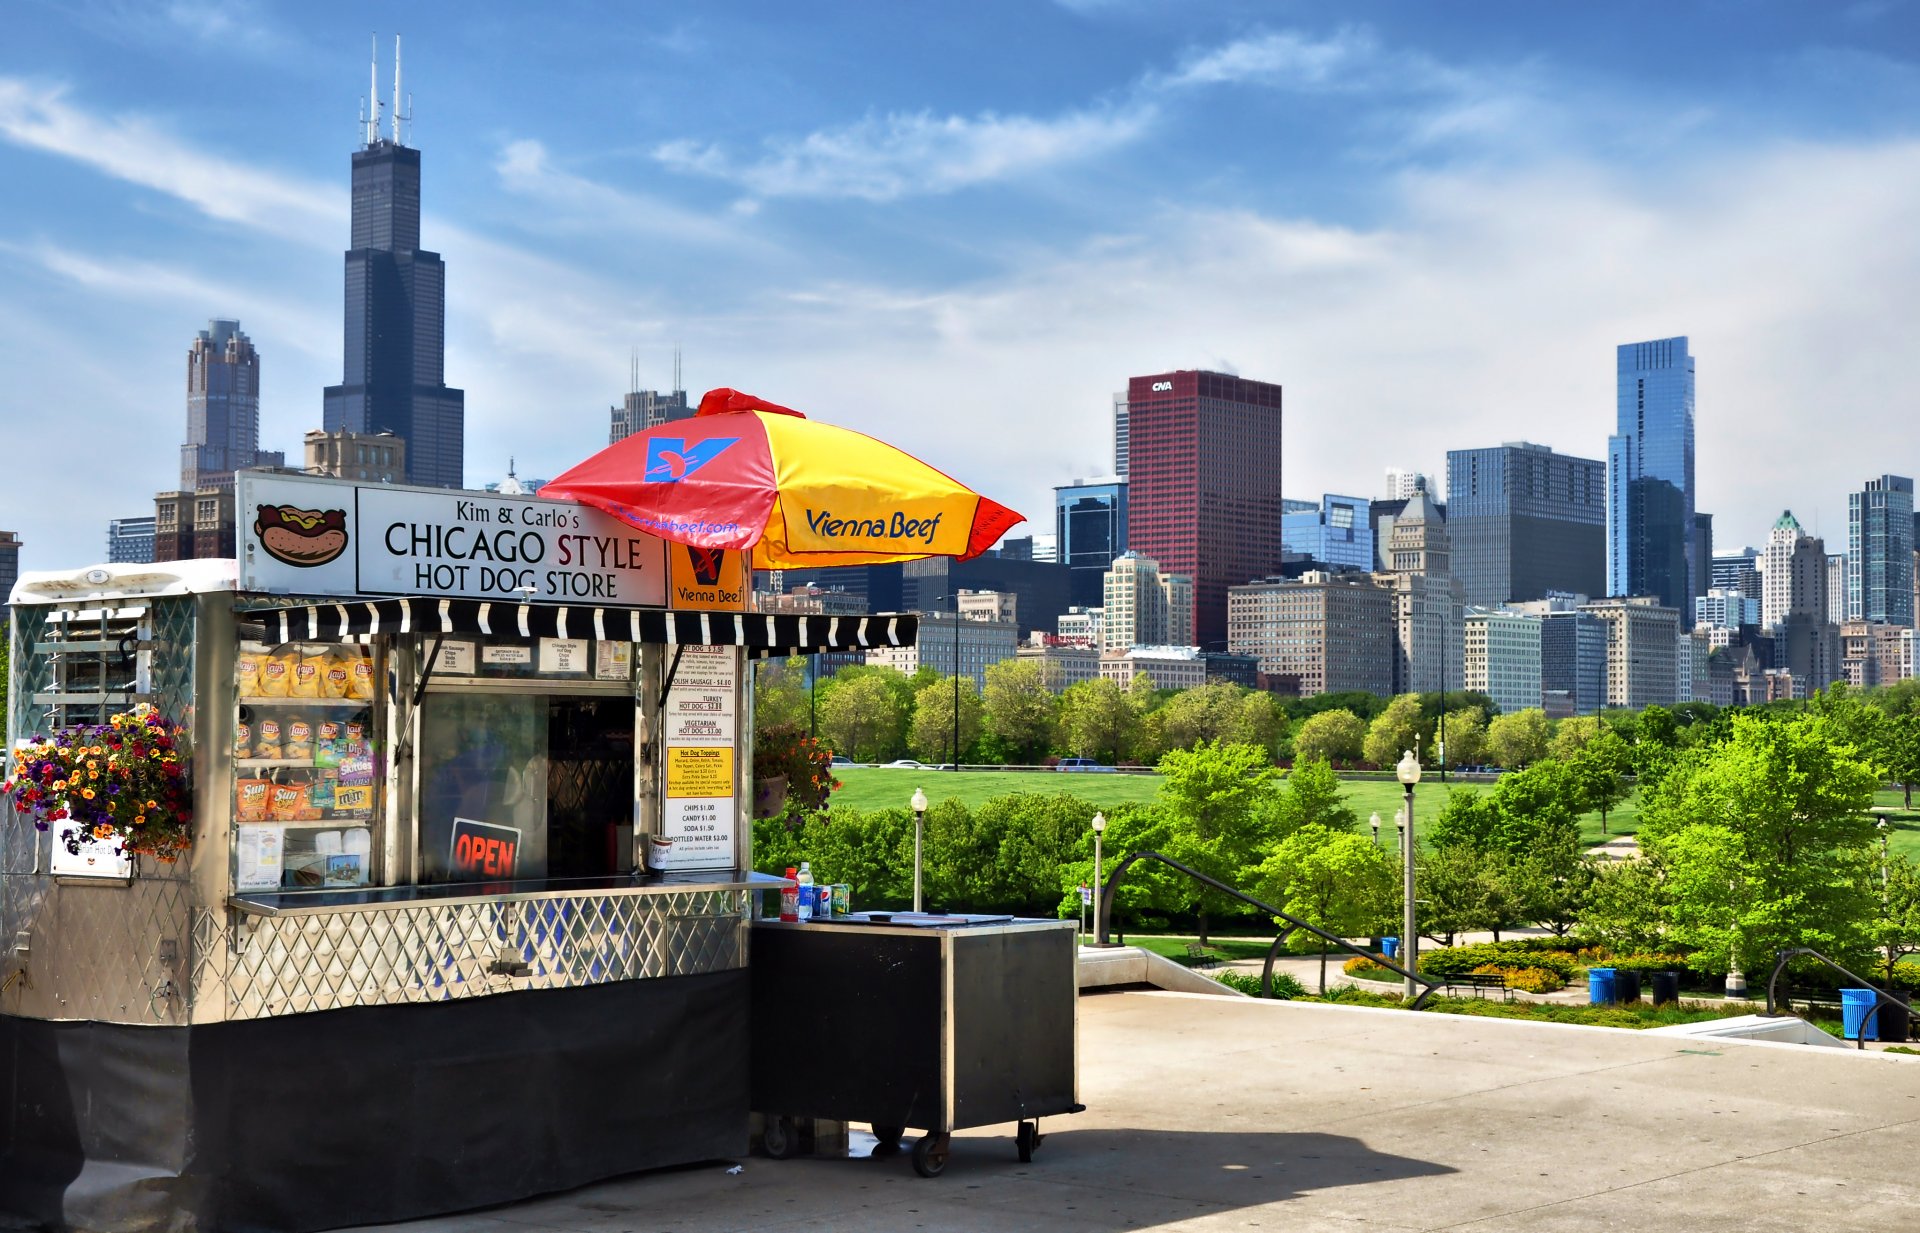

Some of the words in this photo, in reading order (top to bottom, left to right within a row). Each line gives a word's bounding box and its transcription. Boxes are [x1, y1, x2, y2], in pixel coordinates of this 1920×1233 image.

[1152, 382, 1172, 392] CNA
[457, 500, 490, 522] Kim
[498, 507, 514, 524] &
[521, 506, 579, 529] Carlo's
[806, 509, 885, 537] Vienna
[889, 511, 943, 544] Beef
[384, 522, 545, 564] CHICAGO
[558, 534, 643, 570] STYLE
[415, 563, 470, 590] HOT
[481, 567, 536, 594] DOG
[546, 571, 618, 598] STORE
[678, 587, 715, 602] Vienna
[718, 586, 743, 602] Beef
[690, 678, 712, 686] SAUSAGE
[348, 743, 363, 756] Dip
[689, 749, 700, 757] Dog
[700, 749, 720, 757] Toppings
[341, 760, 373, 776] Skittles
[243, 784, 266, 799] Sun
[274, 788, 298, 802] Sun
[455, 833, 514, 877] OPEN
